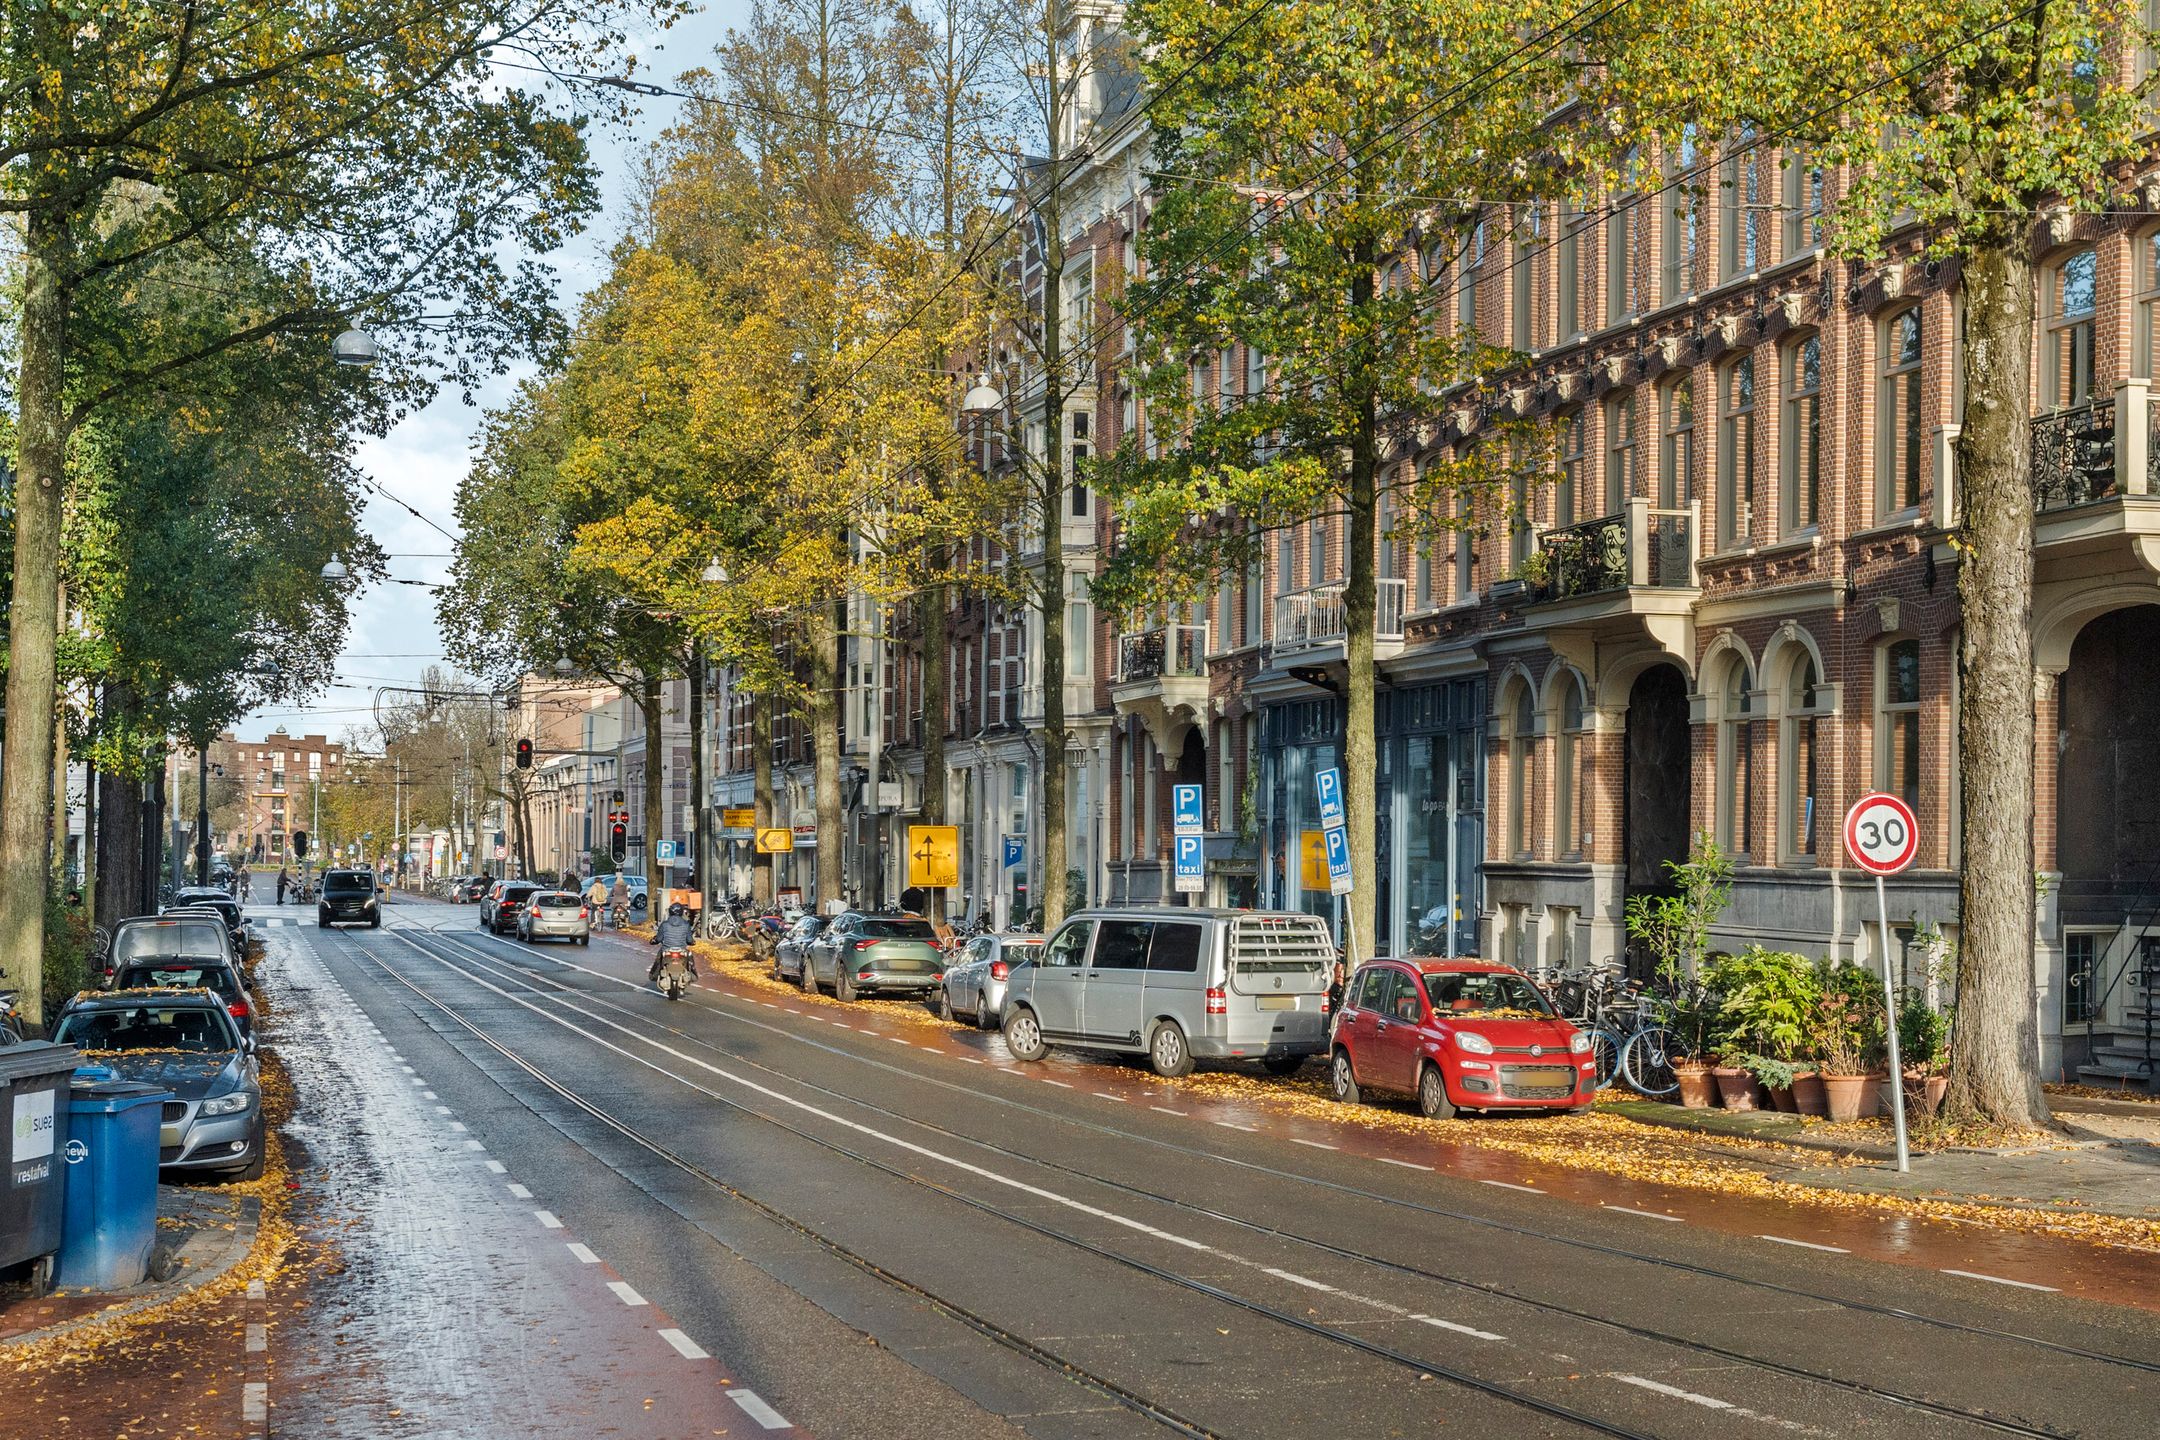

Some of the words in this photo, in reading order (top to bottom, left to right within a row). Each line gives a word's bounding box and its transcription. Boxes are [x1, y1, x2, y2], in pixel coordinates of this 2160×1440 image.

[1321, 774, 1333, 799] P
[1180, 788, 1195, 810] P
[1861, 819, 1904, 849] 30
[661, 843, 672, 857] P
[1010, 848, 1018, 858] P
[1181, 839, 1197, 860] P
[1329, 833, 1341, 858] P
[1178, 864, 1200, 874] taxi
[1331, 861, 1347, 874] taxi
[33, 1115, 53, 1132] suez
[17, 1161, 50, 1184] restafval
